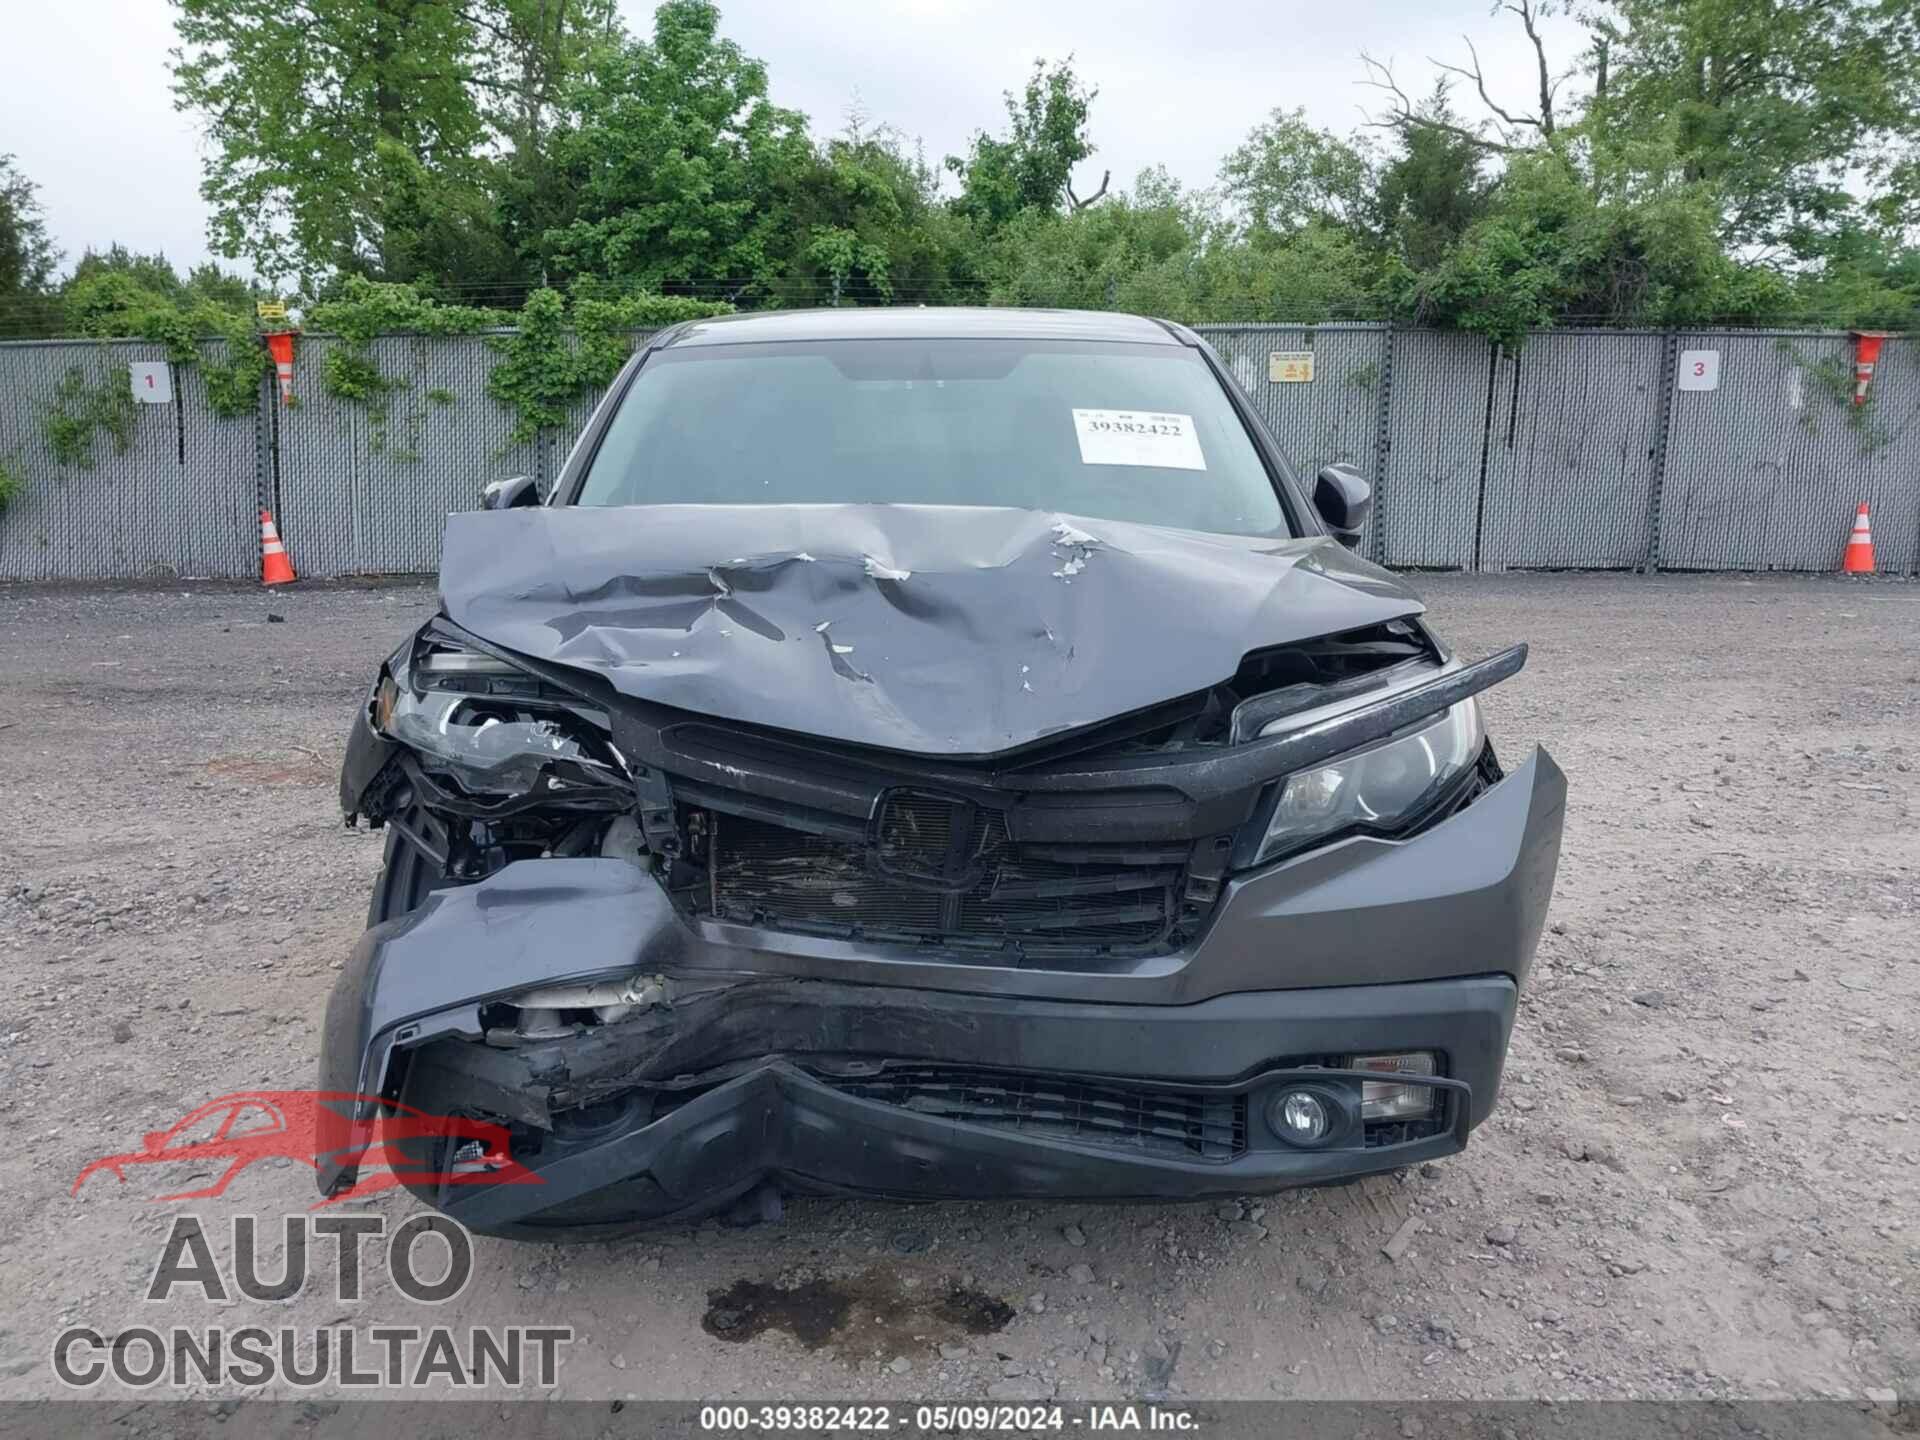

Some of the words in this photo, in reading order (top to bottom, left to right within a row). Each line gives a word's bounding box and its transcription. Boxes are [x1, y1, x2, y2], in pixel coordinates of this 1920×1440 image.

[1693, 362, 1705, 377] 3
[144, 374, 155, 389] 1
[1087, 420, 1183, 437] 39382422
